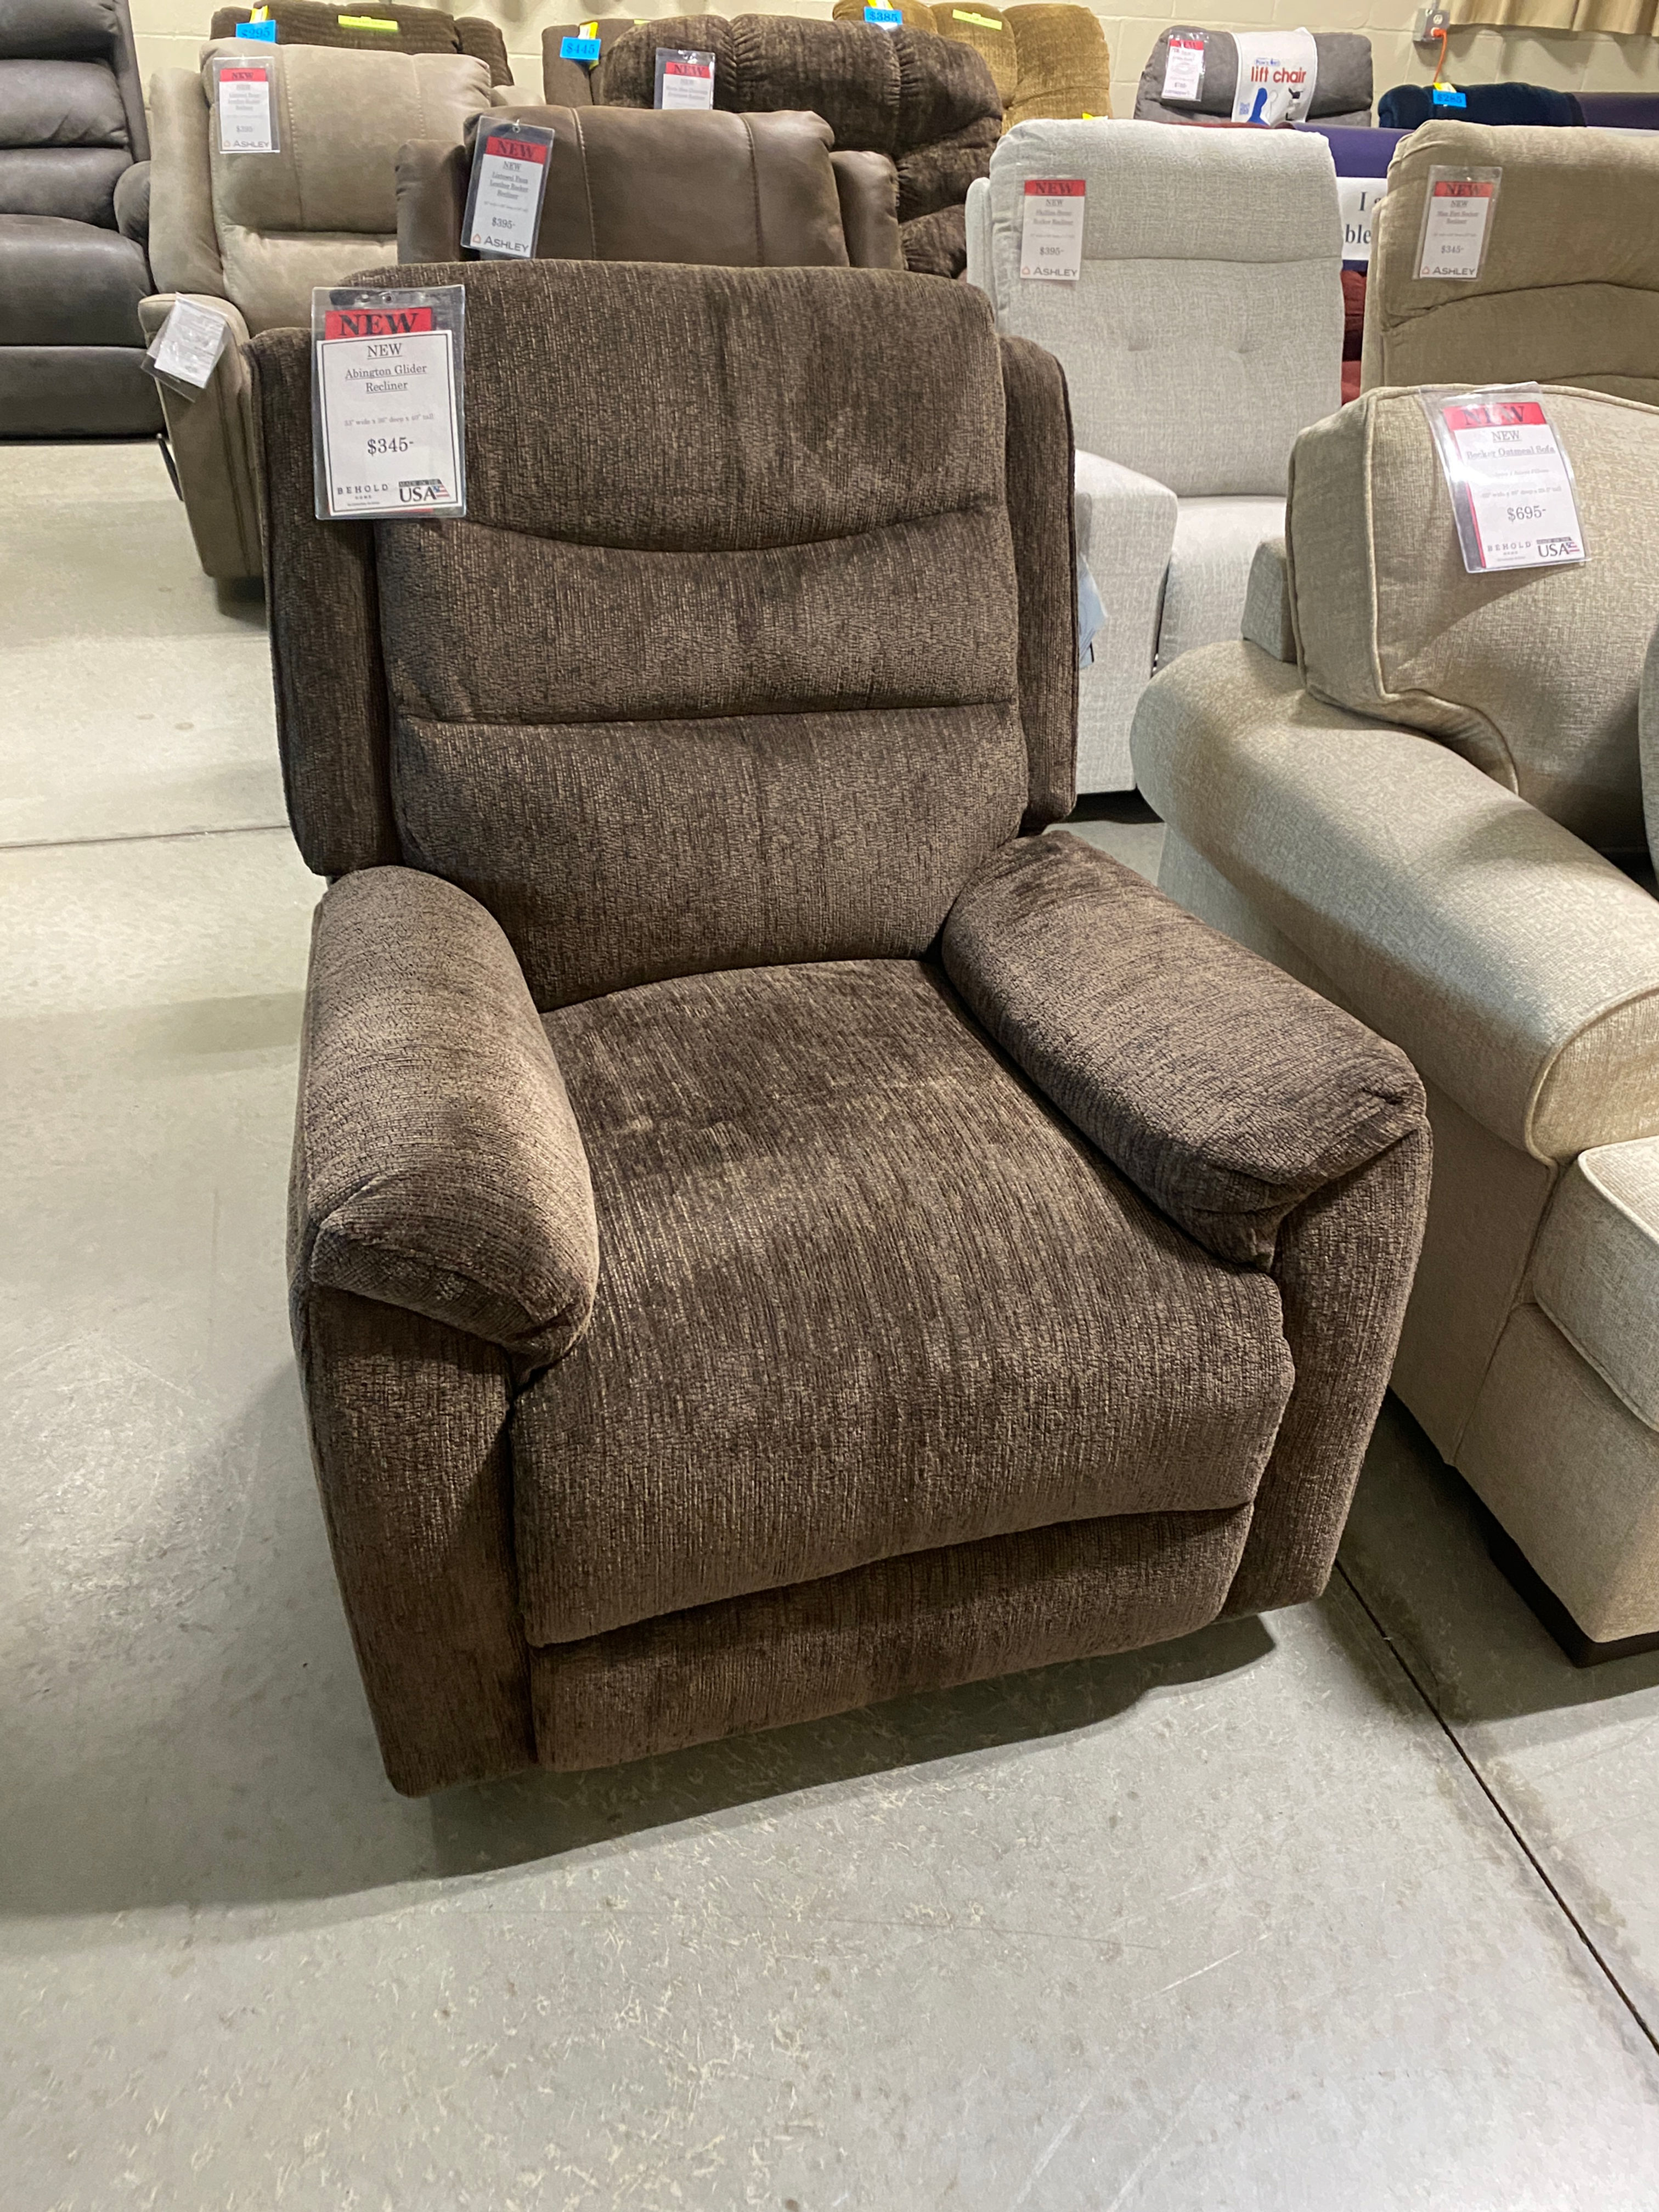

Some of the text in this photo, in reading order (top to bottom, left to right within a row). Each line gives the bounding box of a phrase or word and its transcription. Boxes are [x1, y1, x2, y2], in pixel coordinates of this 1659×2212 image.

[869, 10, 898, 22] $385
[241, 27, 270, 38] $295
[566, 43, 596, 55] $445
[674, 64, 706, 76] NEW
[1251, 66, 1307, 83] lift chair
[233, 140, 269, 148] ASHLEY
[497, 139, 535, 159] NEW
[503, 161, 522, 172] NEW
[1036, 183, 1074, 194] NEW
[1445, 184, 1481, 195] NEW
[1045, 199, 1064, 207] NEW
[484, 236, 529, 253] ASHLEY
[1040, 247, 1064, 256] $395-
[1034, 267, 1077, 276] ASHLEY
[1432, 267, 1476, 275] ASHLEY
[338, 313, 418, 337] NEW
[367, 343, 402, 359] NEW
[345, 364, 428, 381] Abington Glider
[365, 381, 408, 394] Recliner
[1464, 405, 1525, 426] NEW
[1492, 430, 1522, 442] NEW
[368, 438, 414, 456] $345-
[1498, 446, 1534, 456] Oatmeal
[1536, 445, 1556, 454] Sofa
[337, 483, 389, 495] BEHOLD
[399, 486, 437, 503] USA
[1507, 507, 1547, 522] $695-
[1487, 541, 1532, 552] BEHOLD
[1538, 543, 1570, 558] USA
